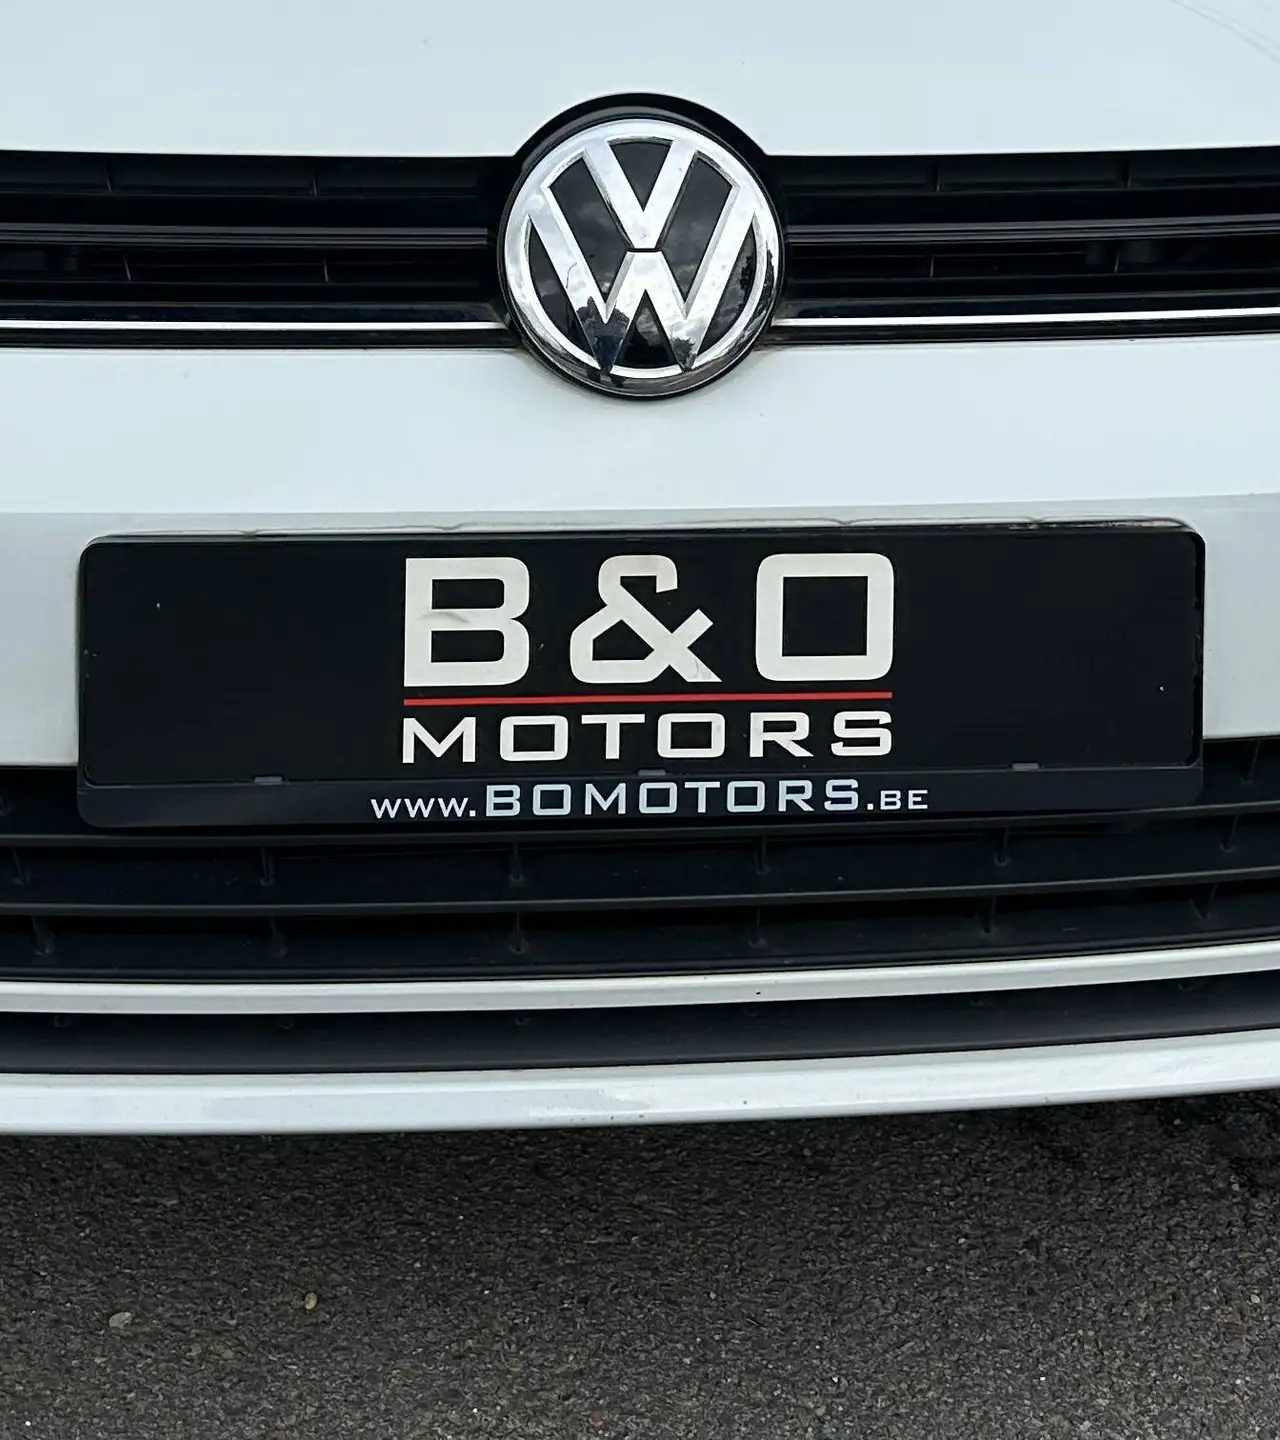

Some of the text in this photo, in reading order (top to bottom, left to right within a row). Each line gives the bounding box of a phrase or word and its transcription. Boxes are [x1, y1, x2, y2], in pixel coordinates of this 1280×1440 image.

[520, 126, 764, 375] VW
[404, 553, 895, 687] B&O
[402, 711, 893, 764] MOTORS
